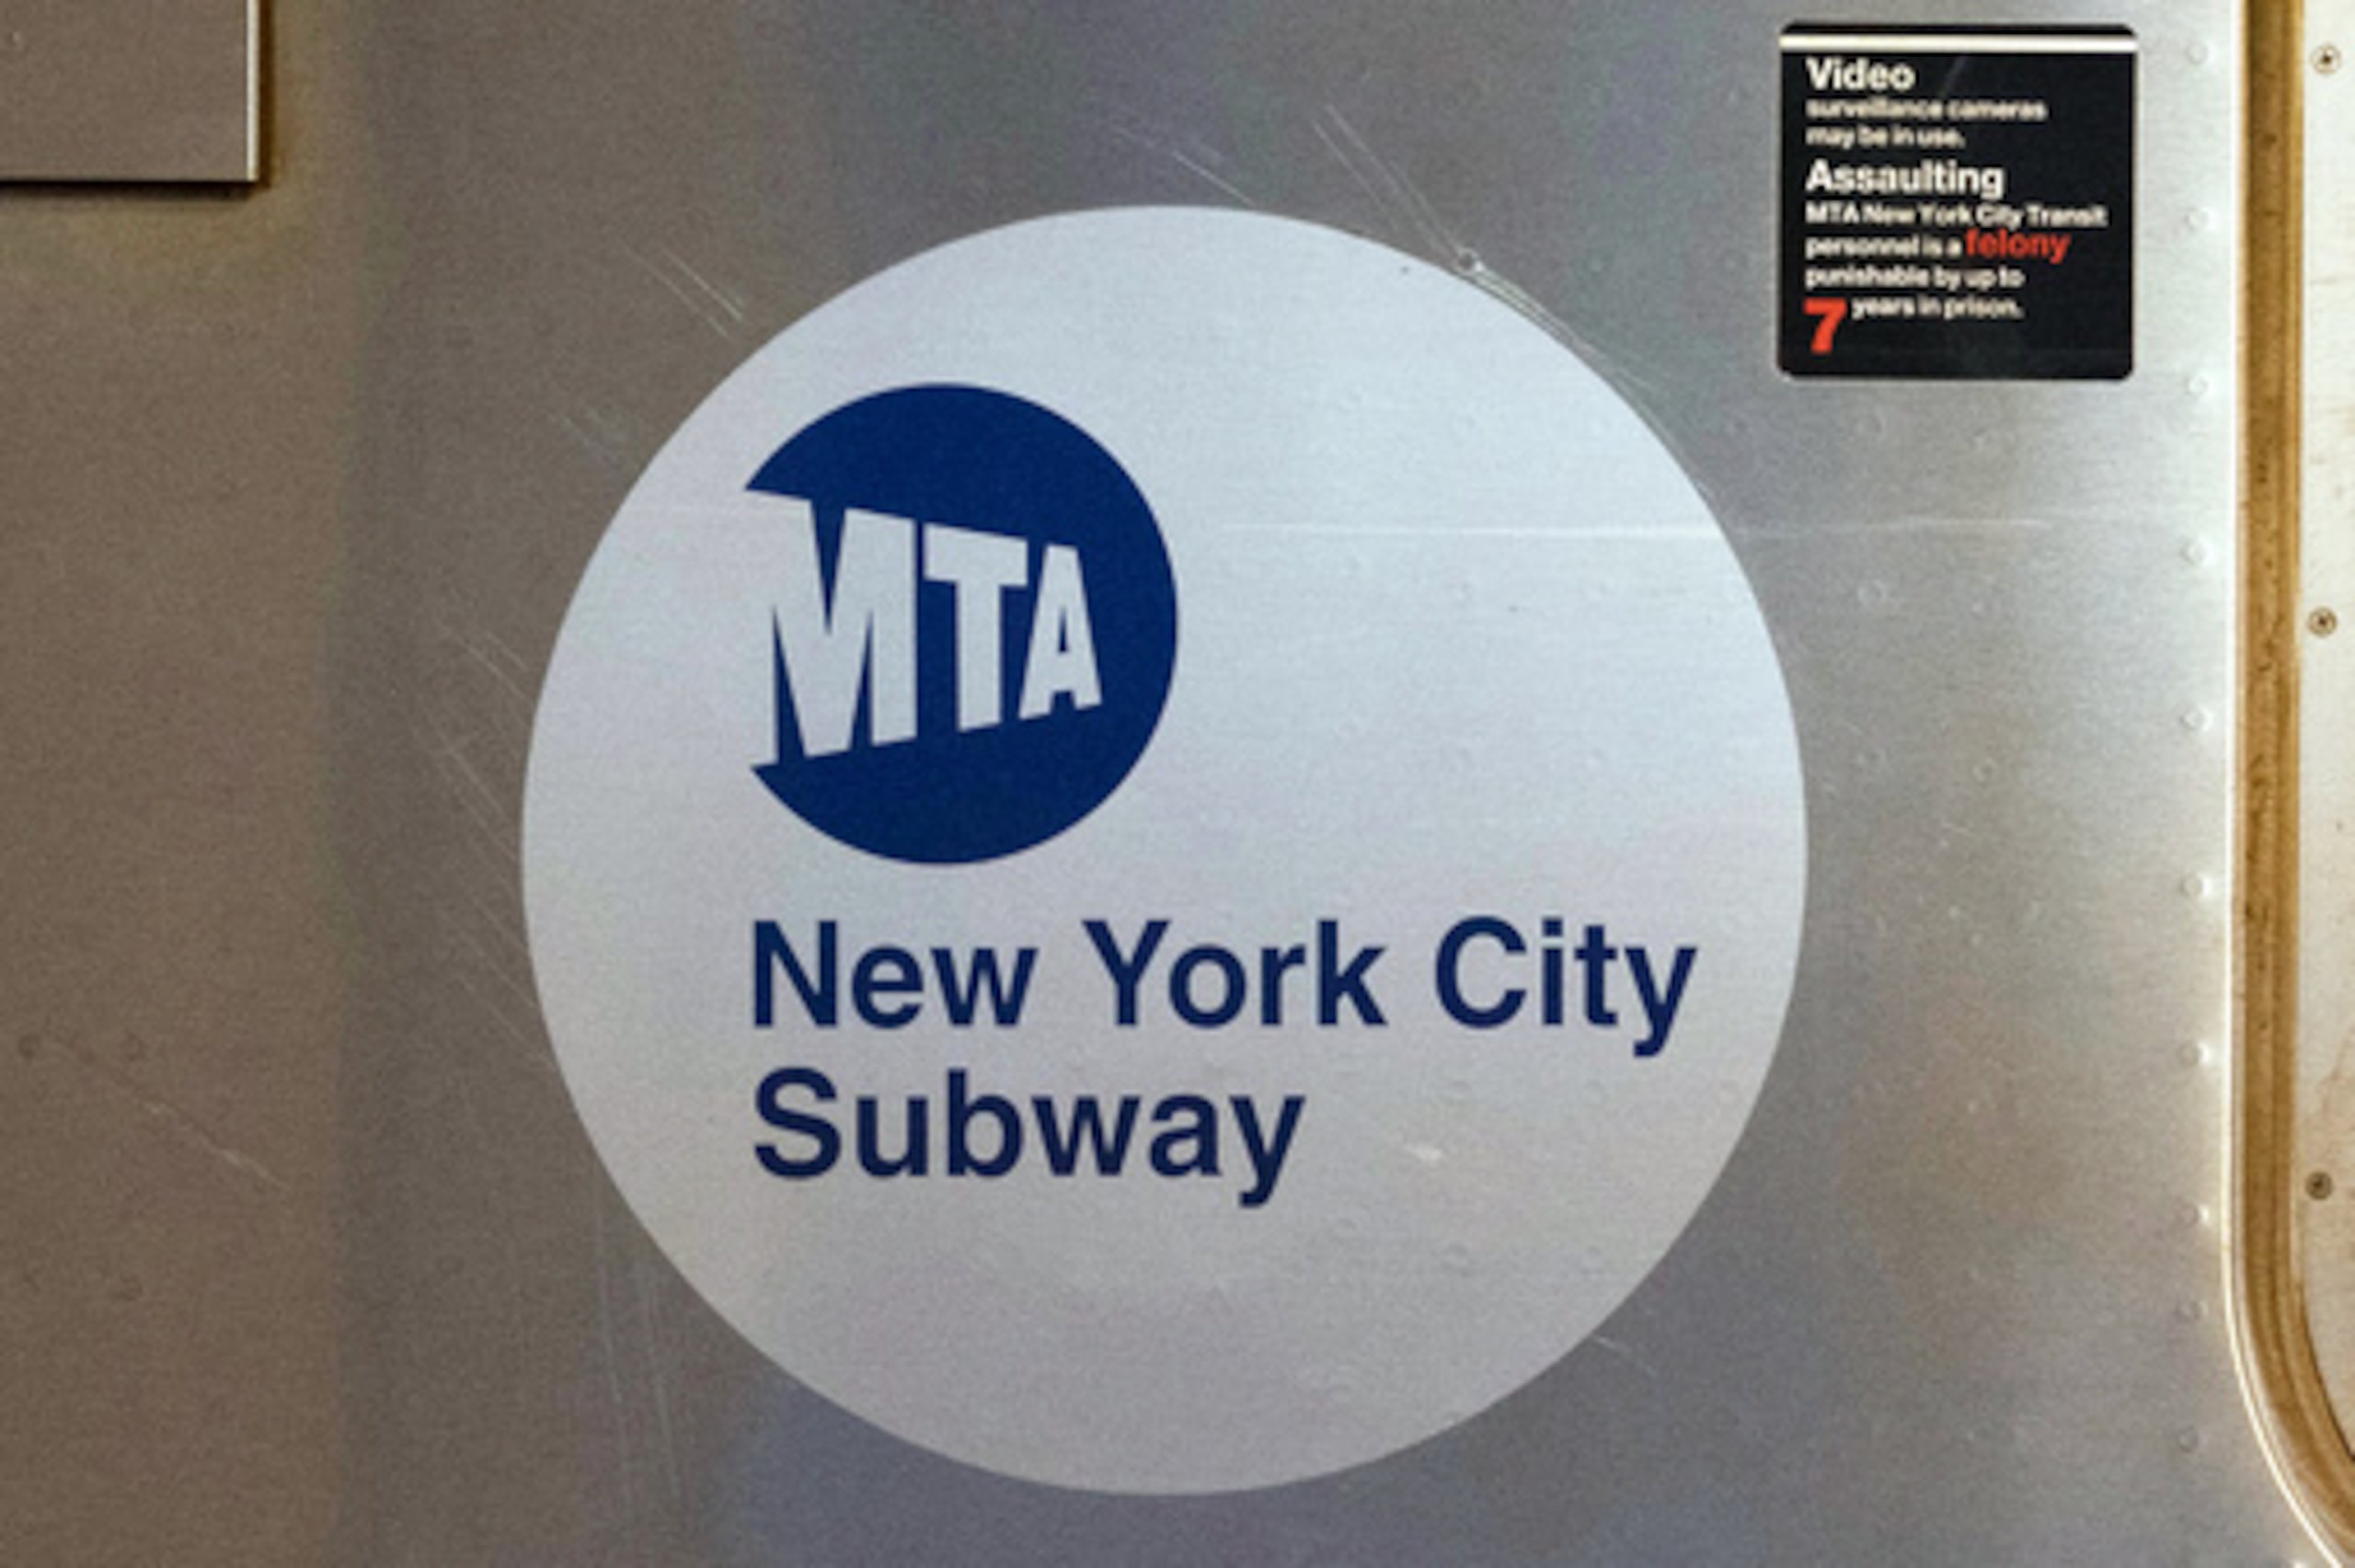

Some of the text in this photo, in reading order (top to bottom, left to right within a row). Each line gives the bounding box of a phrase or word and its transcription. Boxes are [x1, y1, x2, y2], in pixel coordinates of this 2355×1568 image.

[1806, 57, 1916, 90] Video
[1806, 98, 2047, 120] surveillance cameras
[1806, 125, 1966, 149] may be in use.
[1806, 160, 2005, 200] Assaulting
[1806, 203, 2108, 230] MTA New York City Transit
[1806, 228, 2071, 263] personnel is a felony
[1806, 266, 2025, 290] punishable by up to
[1803, 297, 2024, 354] 7 years in prison.
[748, 487, 1104, 765] MTA
[751, 914, 1697, 1057] New York City
[753, 1067, 1305, 1207] Subway
